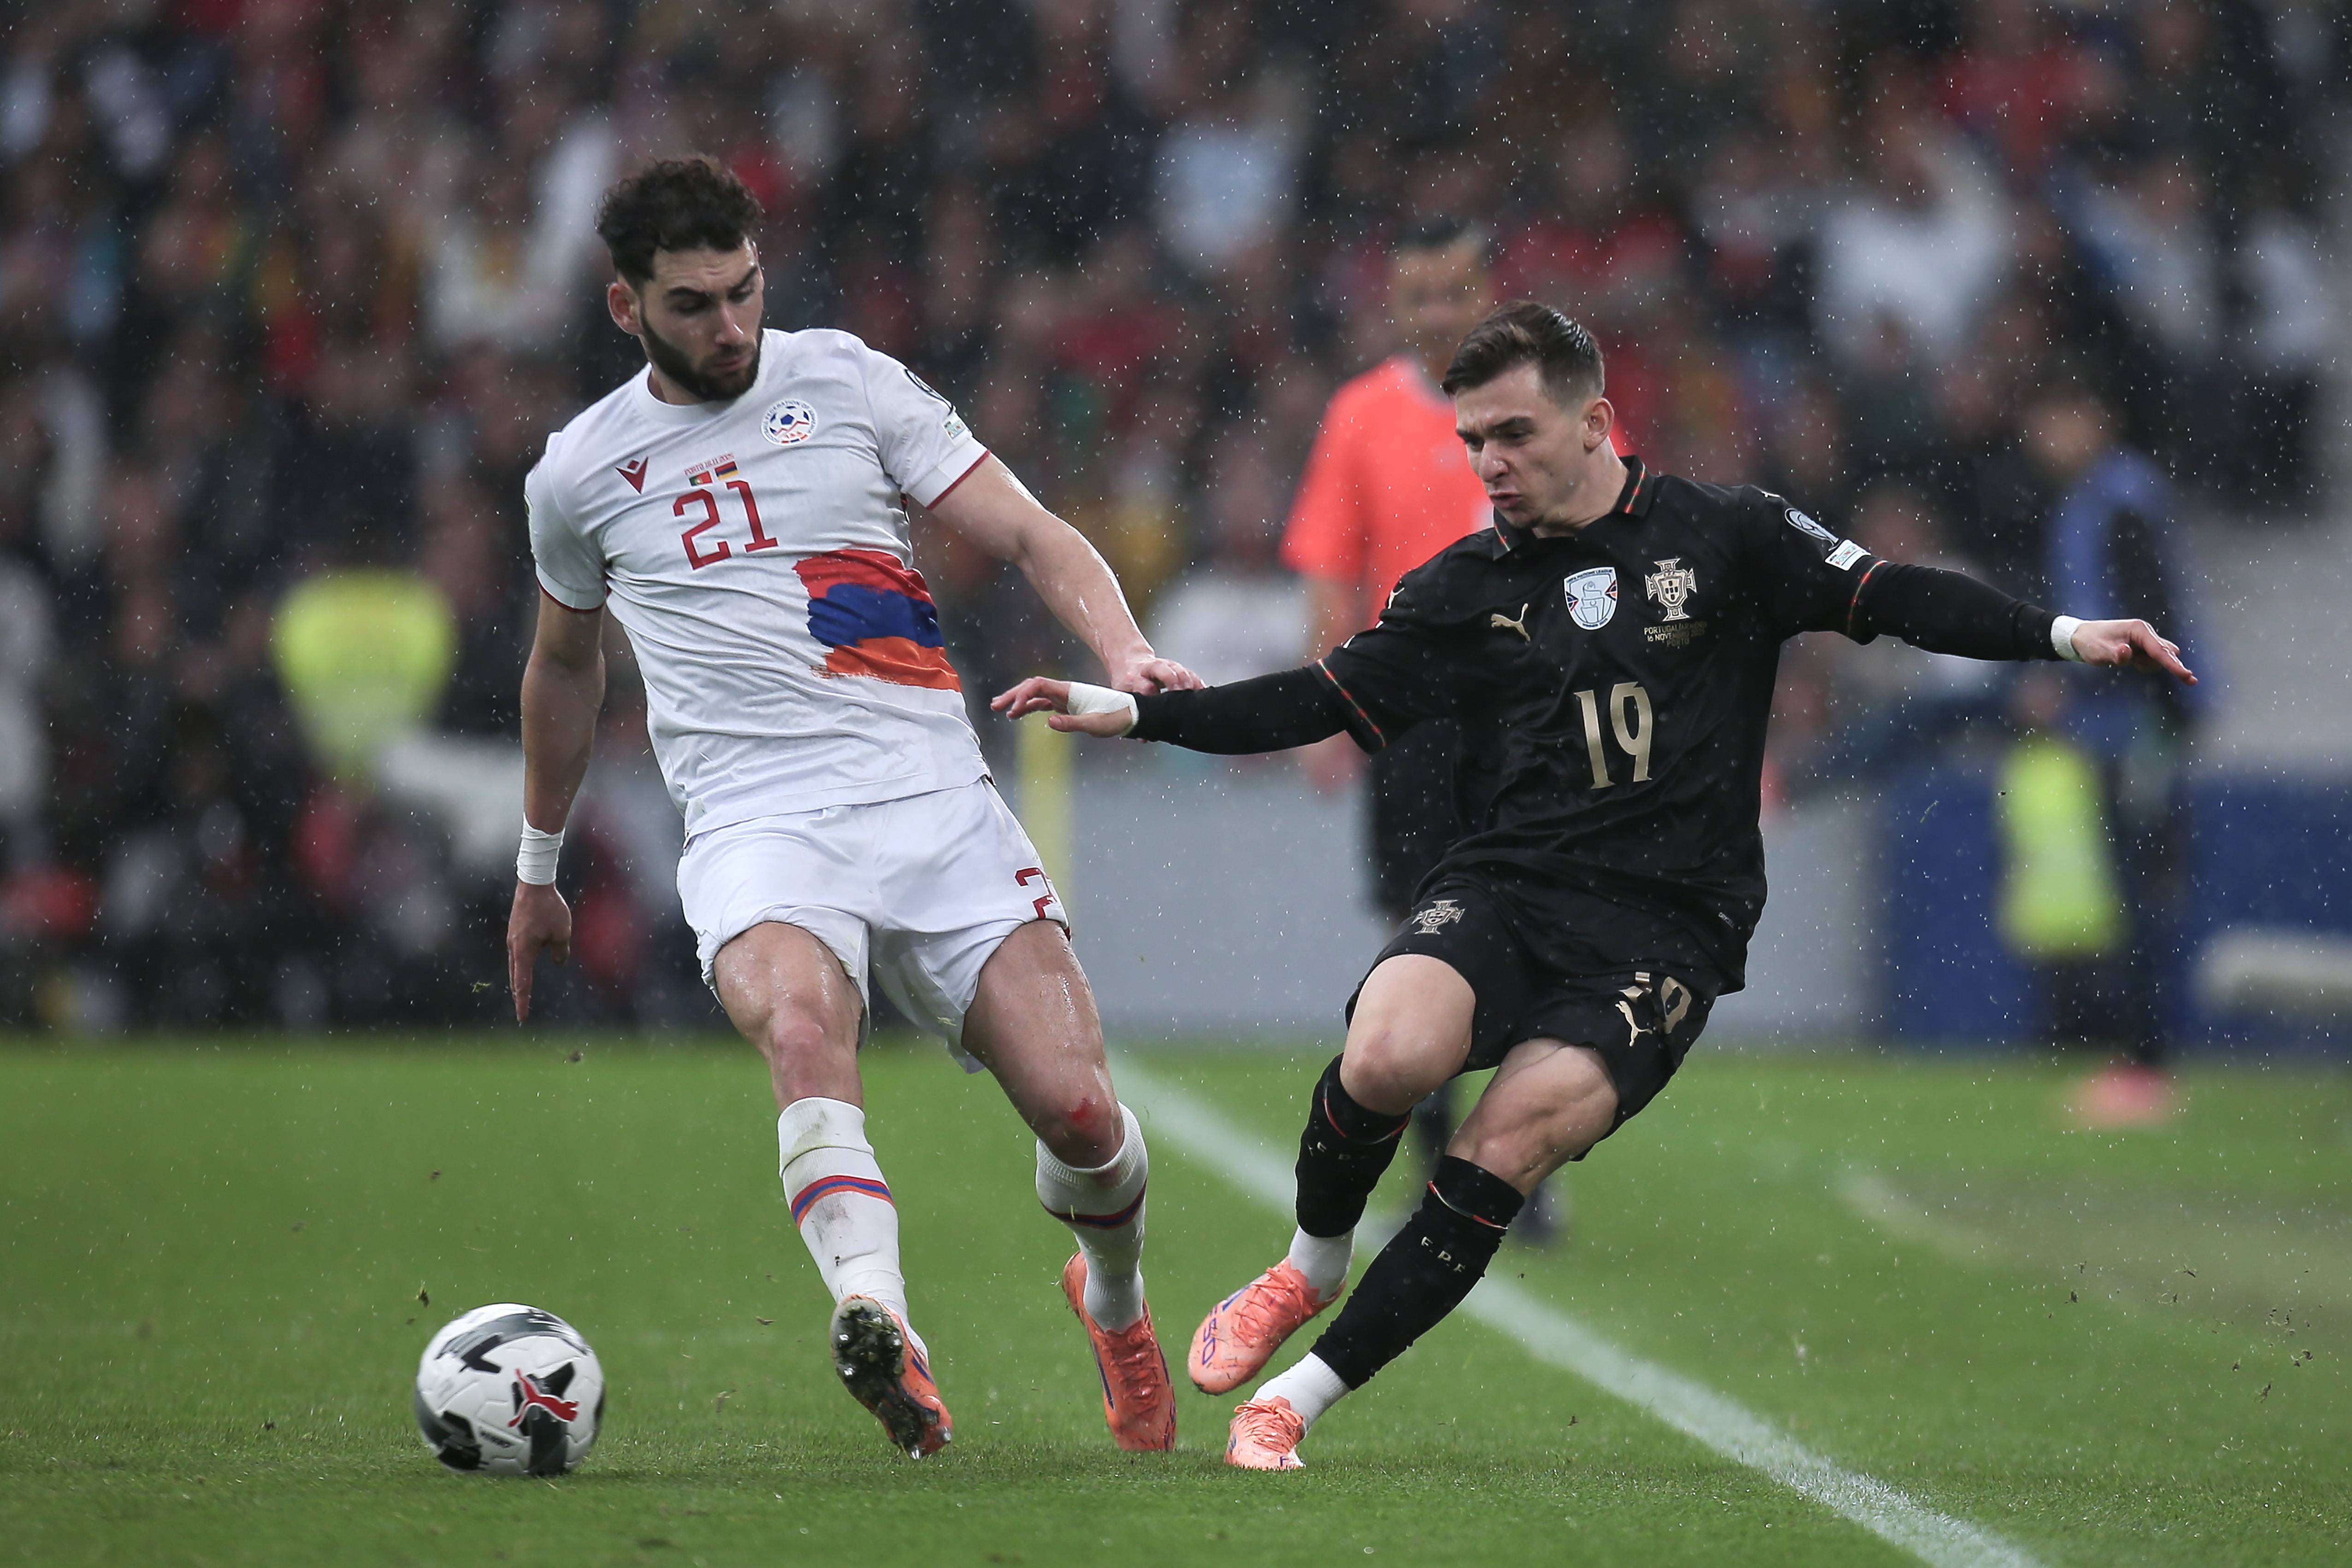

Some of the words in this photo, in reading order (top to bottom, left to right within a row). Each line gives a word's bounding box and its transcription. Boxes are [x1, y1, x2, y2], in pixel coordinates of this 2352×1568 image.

[673, 480, 779, 570] 21
[1666, 638, 1689, 647] PORTO
[1573, 681, 1652, 789] 19
